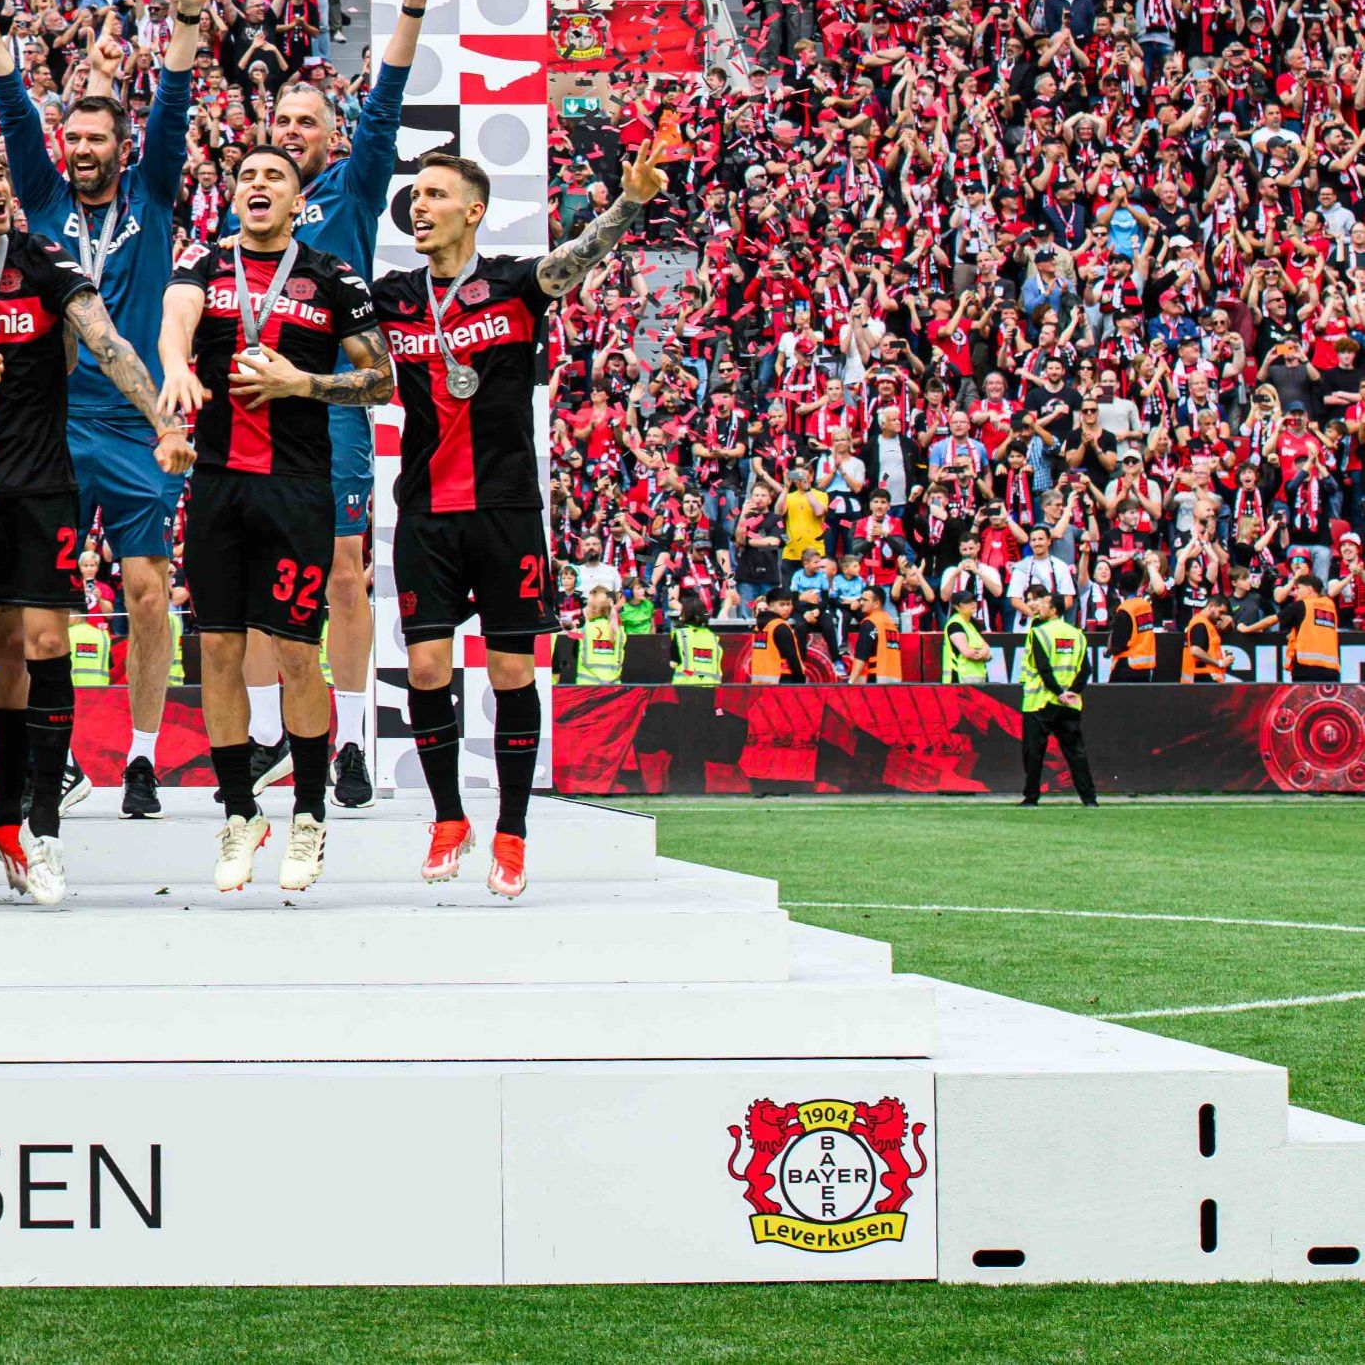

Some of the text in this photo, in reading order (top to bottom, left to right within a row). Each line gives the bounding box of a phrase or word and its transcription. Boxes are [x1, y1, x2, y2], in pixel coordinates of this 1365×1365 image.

[388, 313, 511, 355] Barmenia
[273, 558, 323, 610] 32
[803, 1107, 849, 1124] 1904
[788, 1169, 869, 1183] BAYER
[820, 1136, 836, 1217] BAYER
[763, 1219, 894, 1247] Leverkusen
